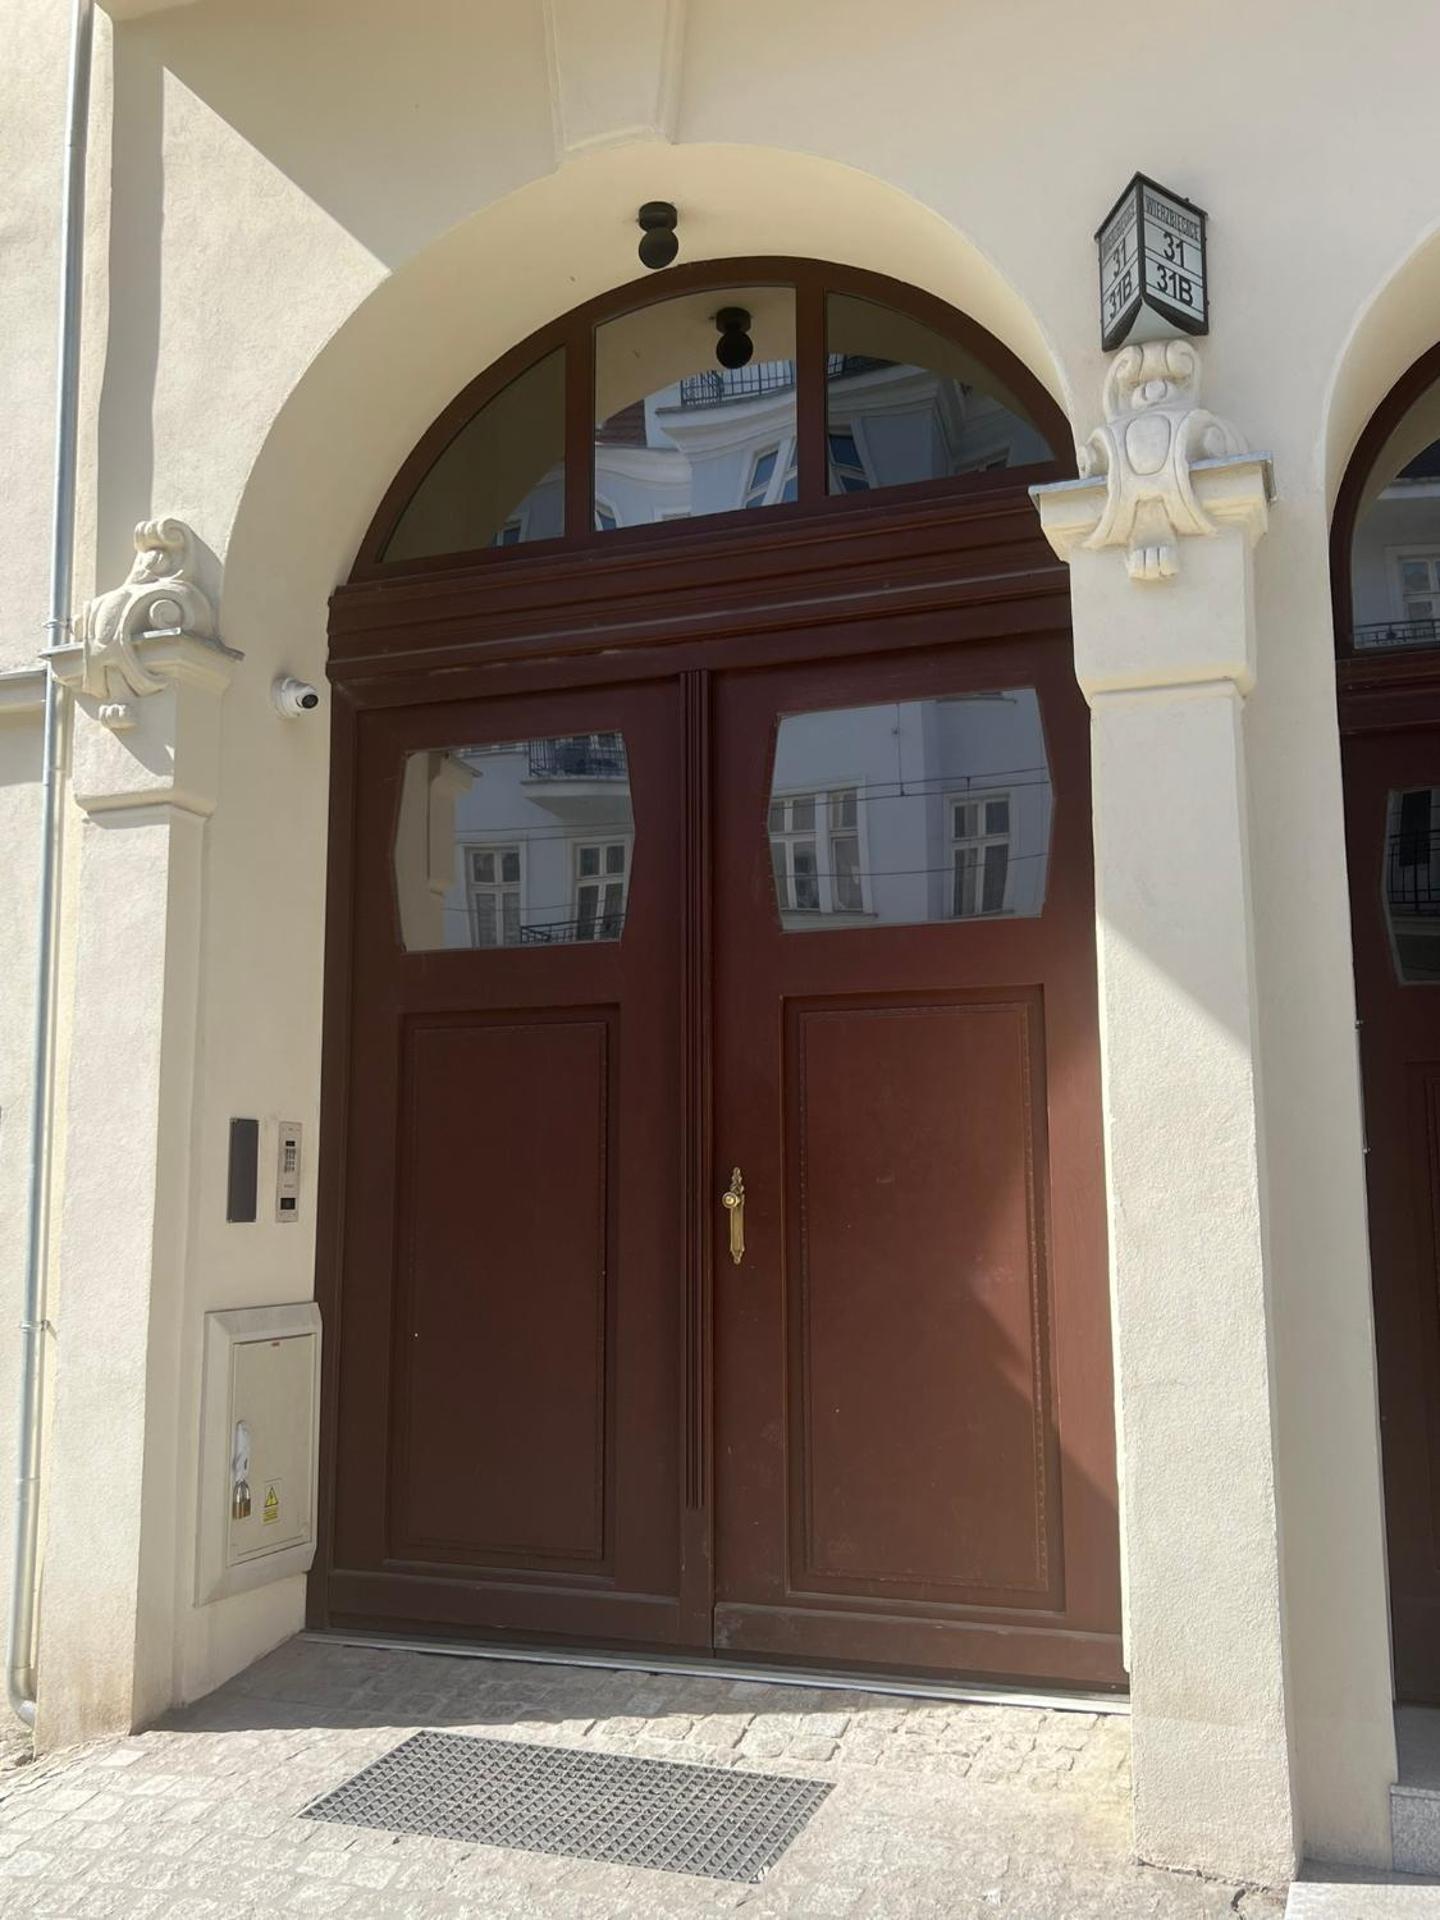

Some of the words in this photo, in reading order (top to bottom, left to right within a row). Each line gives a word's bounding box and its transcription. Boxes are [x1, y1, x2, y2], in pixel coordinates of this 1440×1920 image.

[1113, 239, 1126, 278] 31
[1163, 231, 1185, 268] 31
[1109, 269, 1133, 319] 31B
[1157, 264, 1194, 307] 31B
